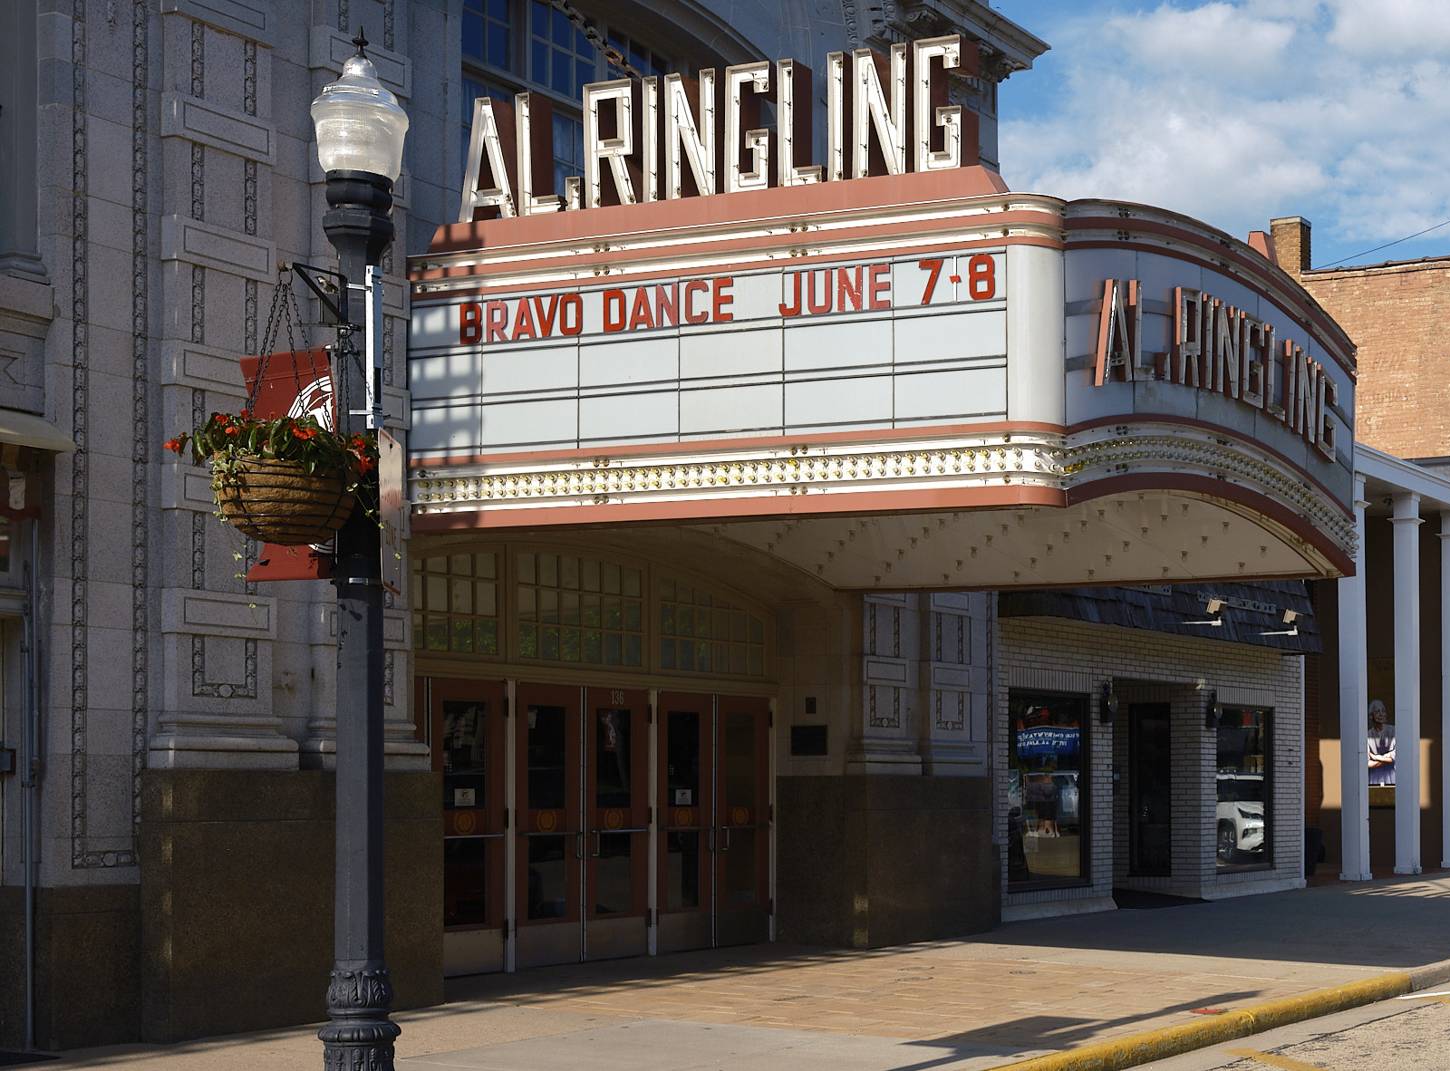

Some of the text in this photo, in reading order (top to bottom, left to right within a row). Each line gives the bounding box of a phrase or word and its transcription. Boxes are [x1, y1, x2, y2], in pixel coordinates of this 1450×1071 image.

[459, 253, 997, 346] BRAVO DANCE JUNE 7-8
[611, 688, 625, 705] 136
